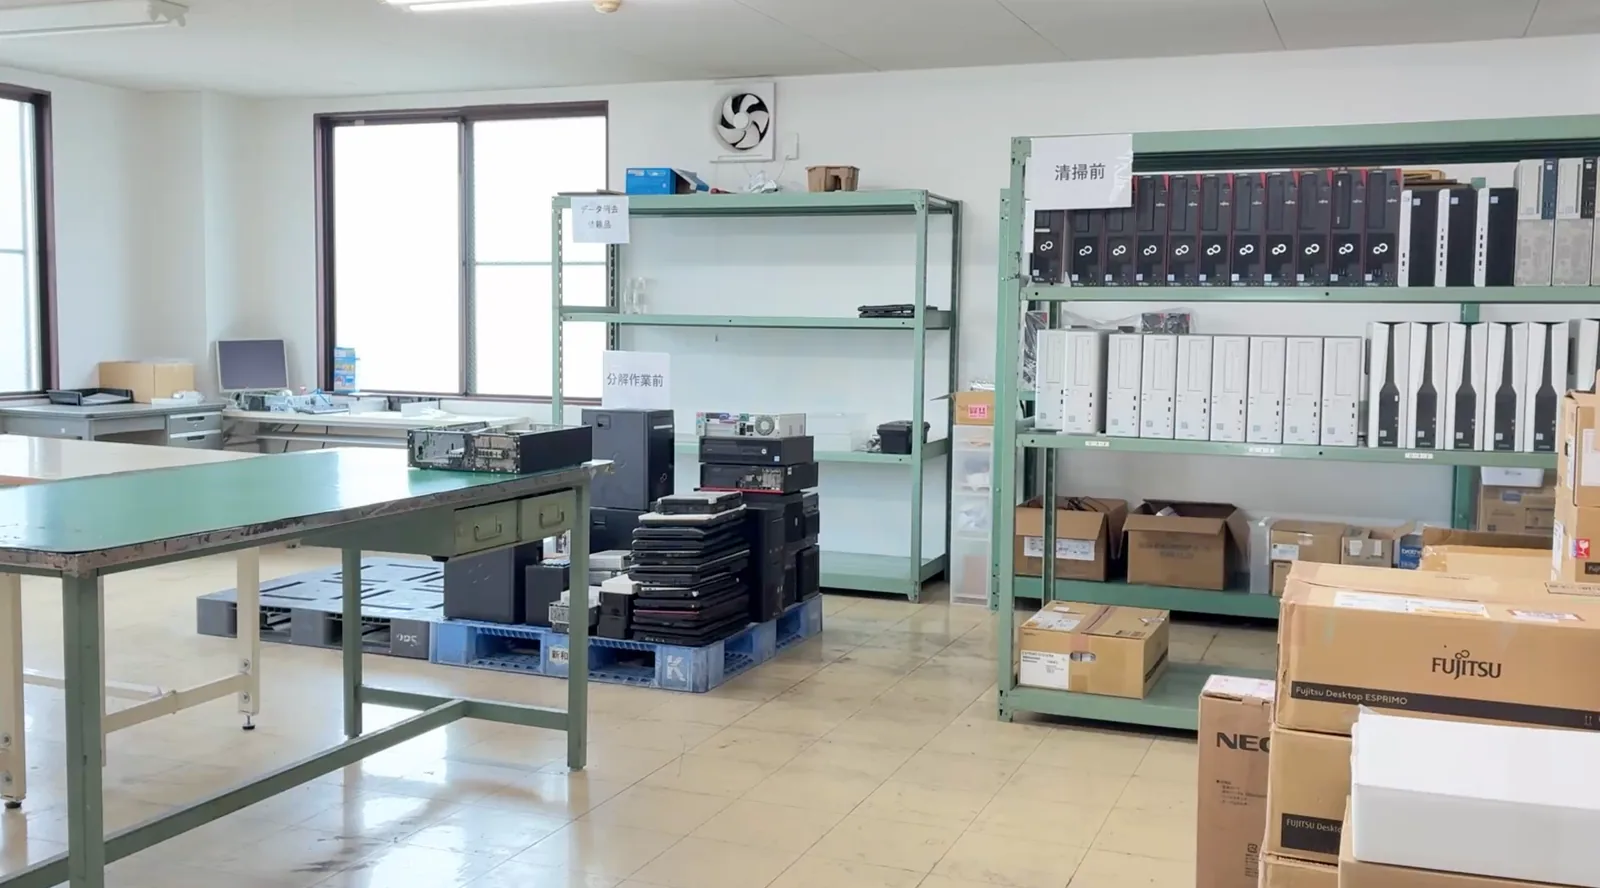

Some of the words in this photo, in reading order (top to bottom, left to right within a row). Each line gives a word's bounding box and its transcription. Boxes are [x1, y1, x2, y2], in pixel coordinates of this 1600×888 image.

[1055, 163, 1106, 181] 清掃前
[606, 372, 664, 388] 分解作業前
[666, 654, 687, 682] K
[1432, 650, 1502, 680] FUJITSU
[1295, 686, 1325, 697] Fujitsu
[1325, 690, 1363, 701] Desktop
[1365, 693, 1408, 705] ESPRIMO
[1286, 818, 1316, 829] FUJITSU
